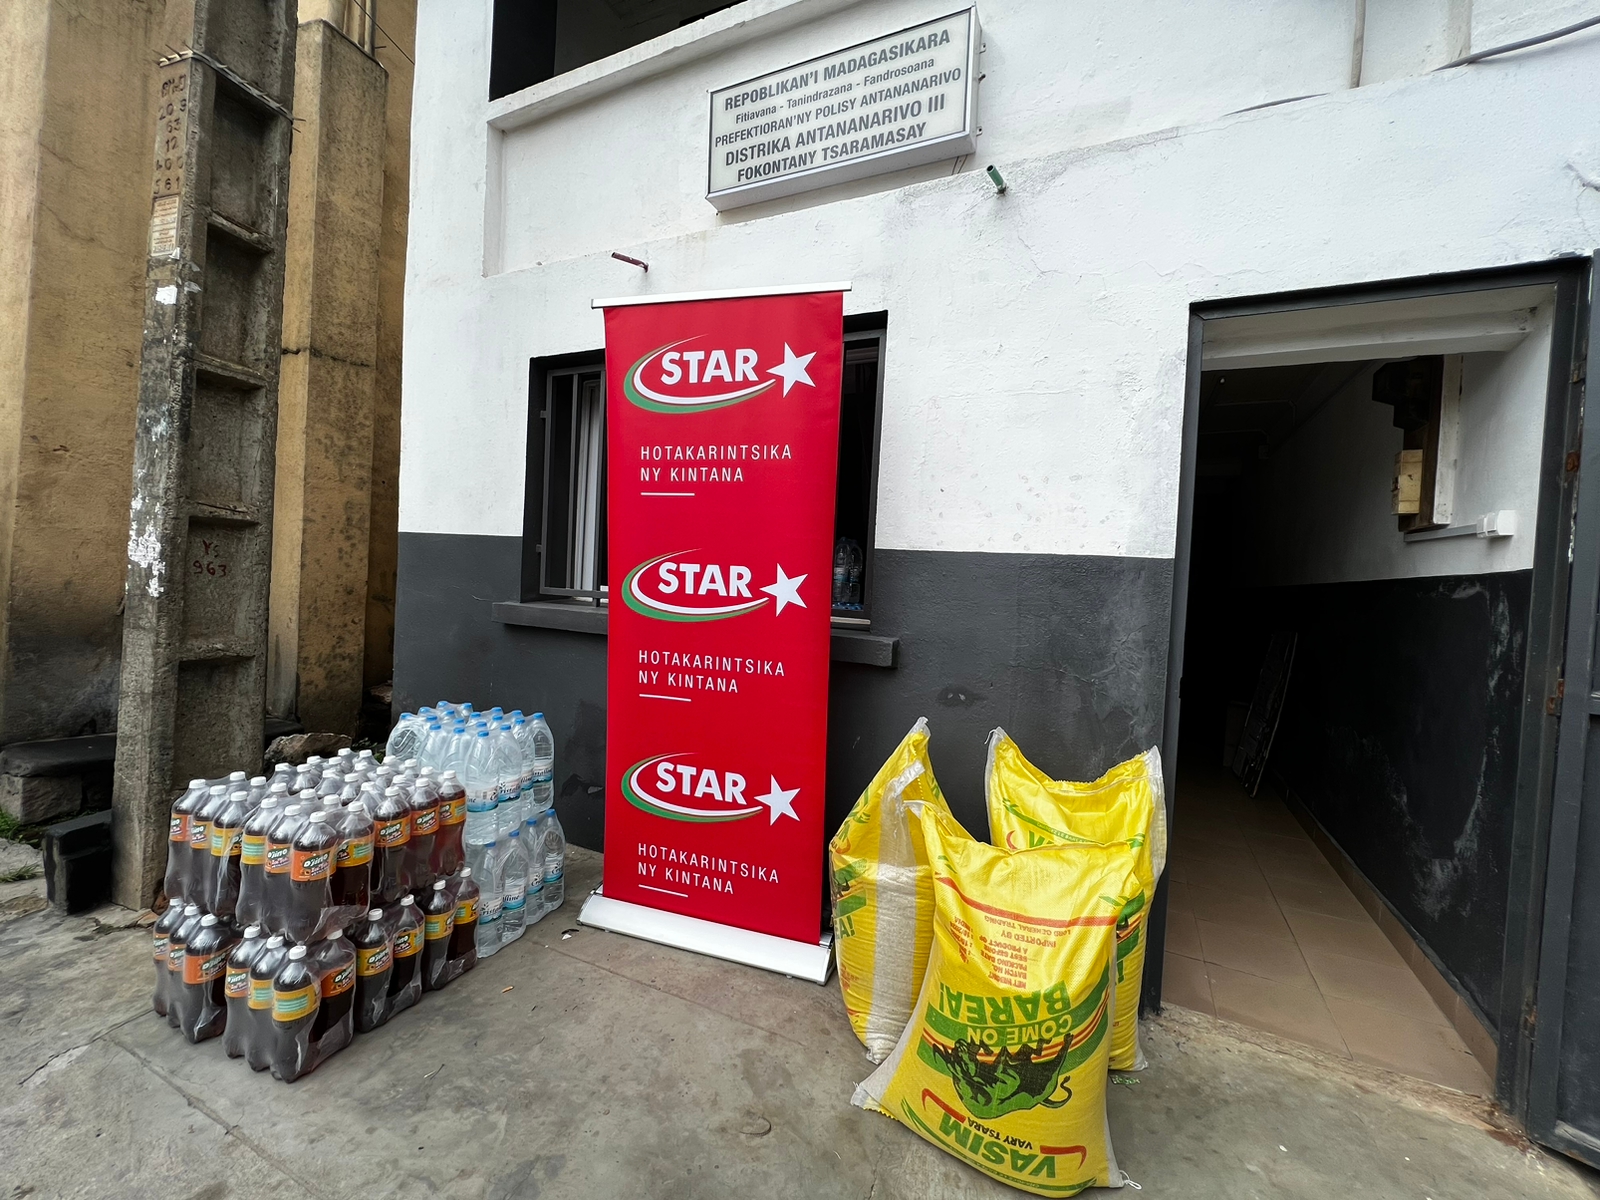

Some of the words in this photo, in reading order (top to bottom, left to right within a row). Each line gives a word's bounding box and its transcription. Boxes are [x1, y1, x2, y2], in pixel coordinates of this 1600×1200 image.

[725, 70, 819, 111] REPOBLIKAN'I
[824, 29, 950, 82] MADAGASIKARA
[736, 106, 776, 124] Fitiavana
[787, 82, 852, 109] Tanindrazana
[864, 58, 934, 87] Fandrosoana
[715, 110, 811, 147] PREFEKTIORAN'NY
[815, 98, 856, 122] POLISY
[860, 68, 961, 108] ANTANANARIVO
[726, 136, 790, 166] DISTRIKA
[795, 100, 922, 148] ANTANANARIVO
[928, 94, 945, 114] III
[738, 150, 816, 182] FOKONTANY
[822, 122, 927, 160] TSARAMASAY
[660, 348, 758, 386] STAR
[641, 444, 792, 461] HOTAKARINTSIKA
[640, 468, 661, 482] NY
[670, 468, 744, 482] KINTANA
[193, 560, 226, 578] 963
[658, 562, 752, 598] STAR
[638, 650, 785, 676] HOTAKARINTSIKA
[638, 670, 659, 684] NY
[668, 672, 738, 693] KINTANA
[656, 762, 746, 805] STAR
[638, 843, 779, 884] HOTAKARINTSIKA
[638, 862, 656, 878] NY
[665, 868, 734, 894] KINTANA
[1000, 930, 1012, 939] BY
[1014, 934, 1056, 948] IMPORTED
[939, 980, 1071, 1025] BAREA!
[967, 1027, 998, 1044] ON
[1006, 1014, 1072, 1042] COME
[940, 1110, 1056, 1178] VASIM
[967, 1117, 1001, 1140] TSARA
[1003, 1135, 1032, 1150] VARY
